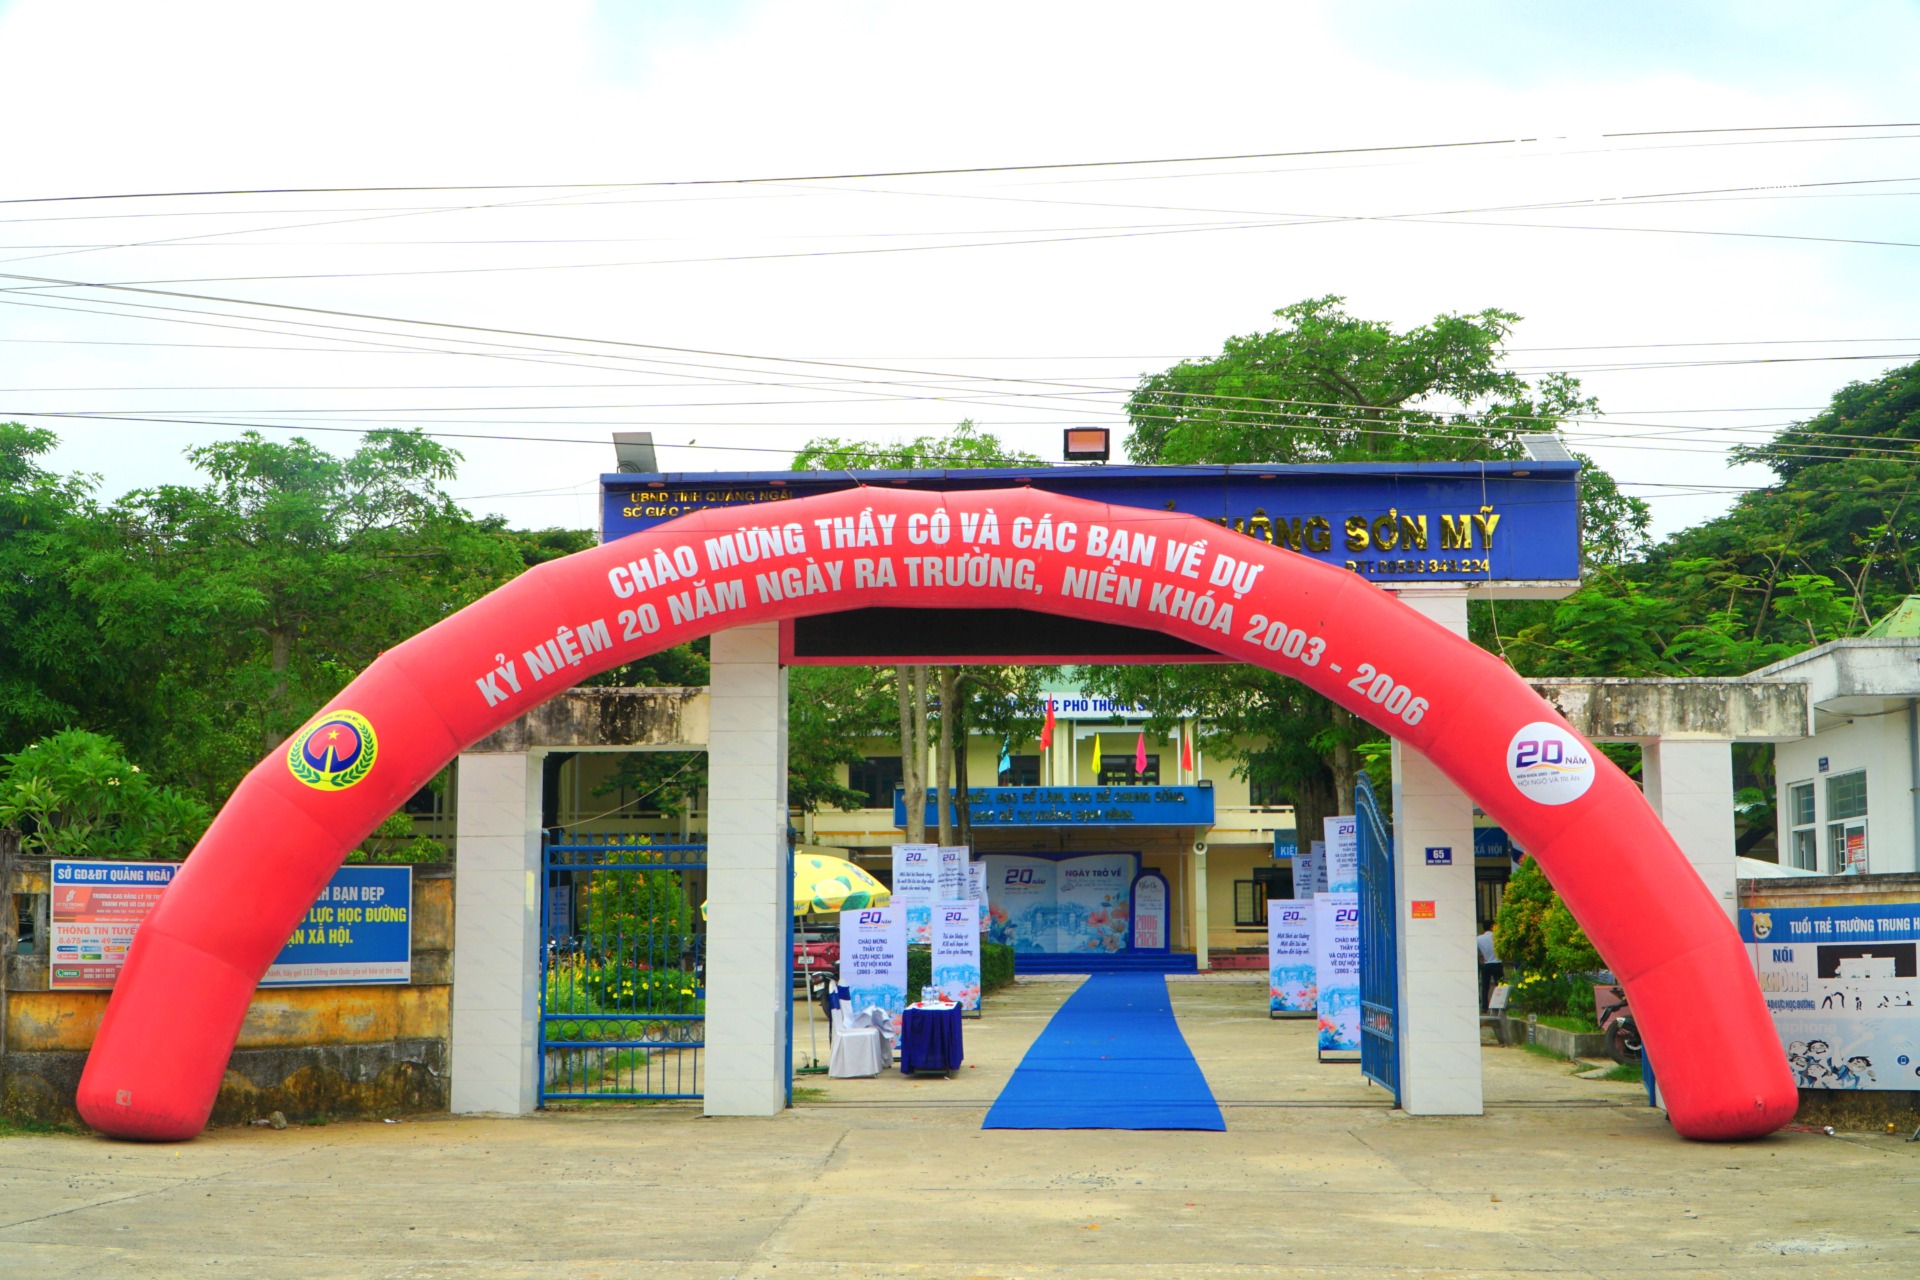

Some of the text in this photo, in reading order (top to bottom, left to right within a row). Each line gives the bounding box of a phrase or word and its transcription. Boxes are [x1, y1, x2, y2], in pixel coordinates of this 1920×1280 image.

[631, 492, 669, 502] UBND
[706, 490, 754, 502] QUẢNG
[646, 505, 679, 518] GIÁO
[1440, 505, 1500, 550] MỸ
[608, 507, 1264, 600] CHÀO MỪNG THẦY CÔ VÀ CÁC BẠN VỀ DỰ
[476, 653, 522, 707] KỶ
[522, 618, 613, 682] NIỆM
[618, 603, 660, 642] 20
[666, 578, 747, 625] NĂM
[758, 560, 844, 604] NGÀY
[853, 556, 897, 589] RA
[903, 552, 1043, 596] TRƯỜNG,
[1062, 564, 1140, 608] NIÊN
[1149, 582, 1233, 636] KHÓA
[1242, 613, 1326, 668] 2003
[1347, 662, 1428, 726] 2006
[1516, 740, 1587, 768] 20 NĂM
[906, 853, 921, 861] 20
[1433, 850, 1444, 858] 65
[58, 865, 170, 882] SỞ GD&ĐT QUẢNG NGÃI
[1005, 869, 1033, 884] 20
[1065, 867, 1122, 877] NGÀY TRỞ VỀ
[333, 886, 358, 904] BẠN
[361, 886, 385, 904] ĐẸP
[310, 906, 334, 926] LỰC
[337, 907, 362, 926] HỌC
[365, 904, 407, 922] ĐƯỜNG
[859, 912, 882, 924] 20
[945, 912, 961, 921] 20
[1283, 911, 1299, 920] 20
[1336, 909, 1358, 922] 20
[57, 925, 90, 935] THÔNG
[94, 926, 108, 934] TIN
[1790, 916, 1910, 934] TUỔI TRẺ TRƯỜNG TRUNG
[287, 930, 304, 948] ẠN
[308, 926, 325, 944] XÃ
